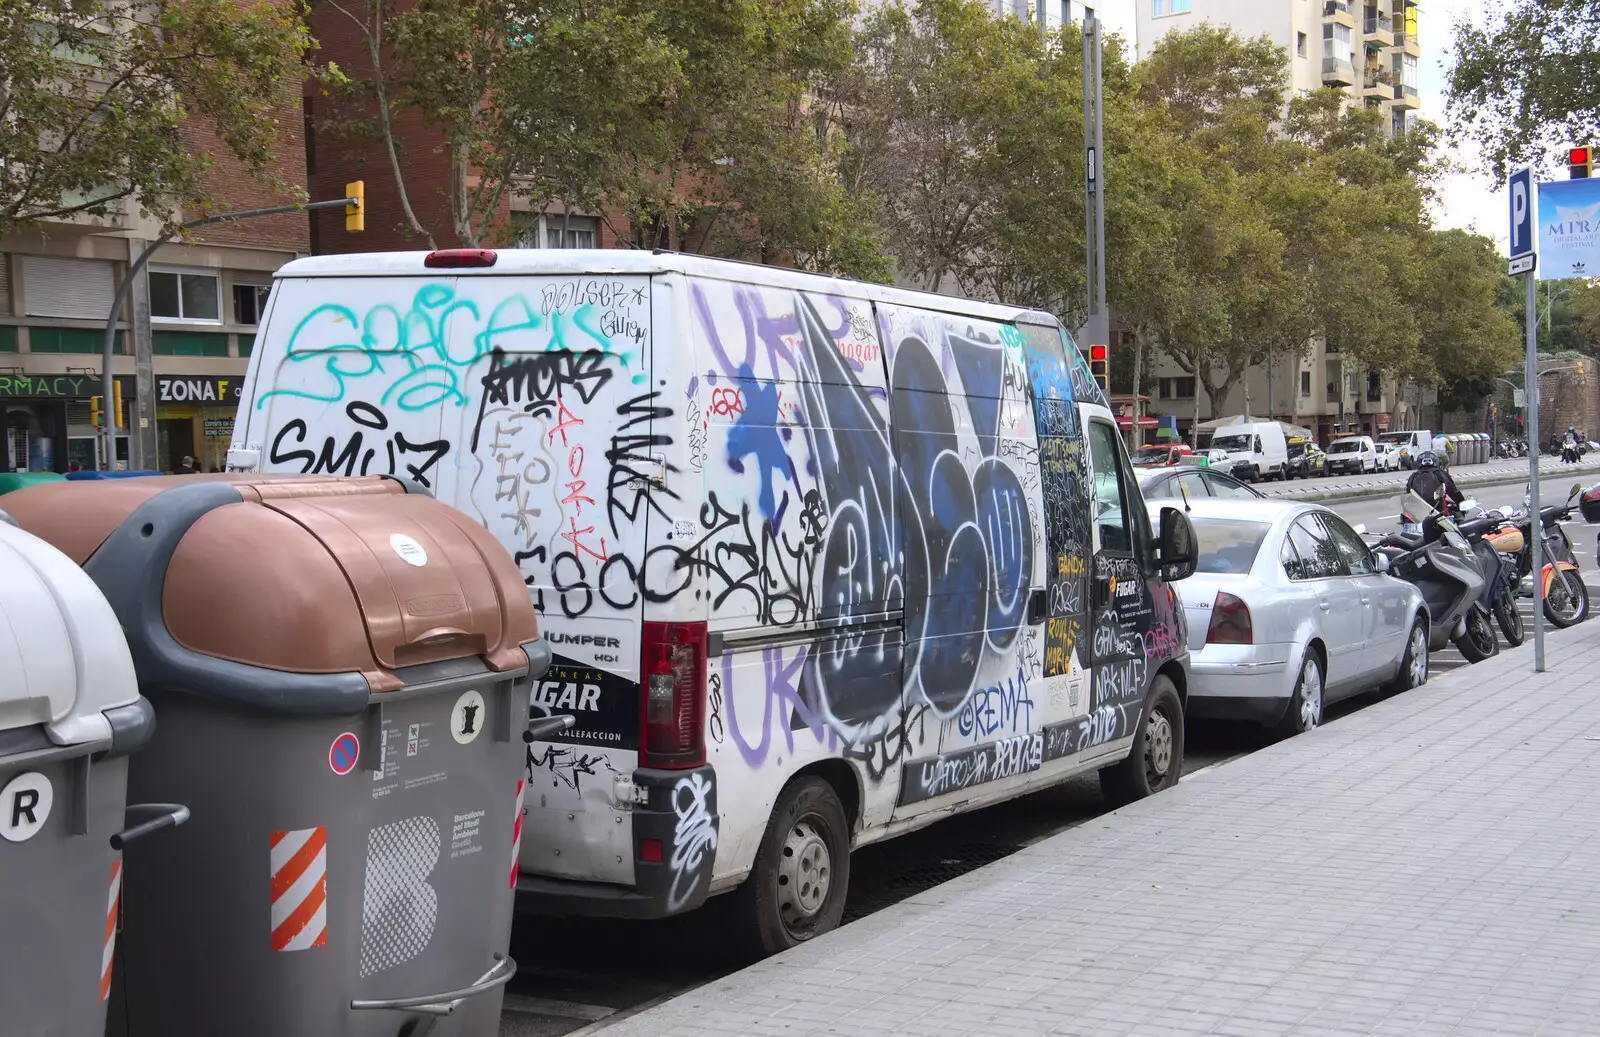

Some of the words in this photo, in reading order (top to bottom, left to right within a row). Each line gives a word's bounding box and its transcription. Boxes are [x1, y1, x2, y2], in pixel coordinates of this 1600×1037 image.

[1512, 180, 1527, 248] P
[1561, 241, 1595, 249] FESTIVAL
[159, 380, 216, 401] ZONA
[218, 380, 229, 401] F
[1116, 580, 1136, 597] FUGAR
[11, 788, 40, 828] R
[453, 810, 485, 823] Barcelona
[453, 827, 479, 840] Ambient
